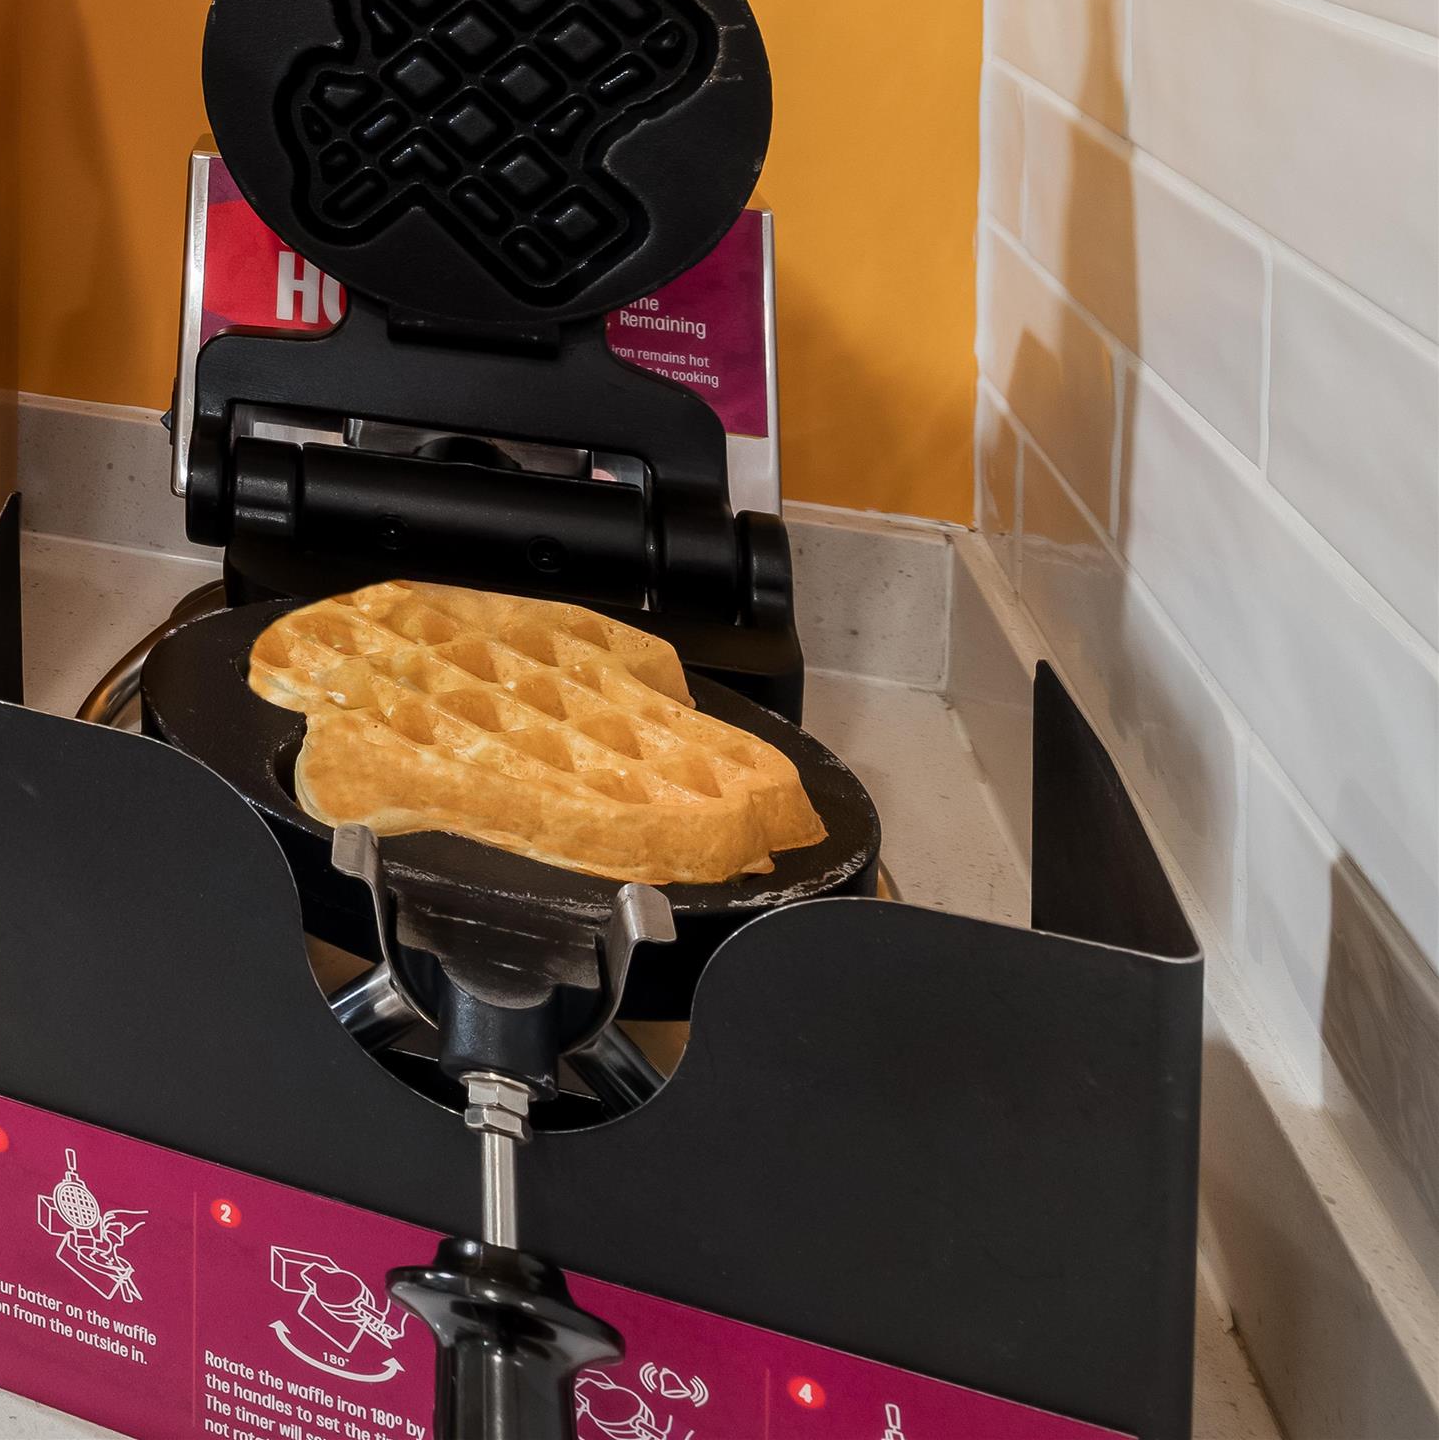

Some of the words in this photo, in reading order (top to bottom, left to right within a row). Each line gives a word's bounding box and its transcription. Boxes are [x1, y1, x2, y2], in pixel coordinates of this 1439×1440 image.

[619, 310, 706, 339] Remaining
[637, 350, 686, 365] remains
[689, 353, 710, 368] hot
[672, 369, 719, 388] cooking
[220, 1204, 234, 1224] 2
[18, 1284, 63, 1311] batter
[65, 1303, 83, 1320] on
[86, 1309, 110, 1329] the
[113, 1320, 157, 1346] waffle
[13, 1303, 46, 1328] from
[49, 1317, 73, 1338] the
[76, 1328, 129, 1357] outside
[131, 1345, 148, 1365] in.
[205, 1350, 255, 1381] Rotate
[258, 1368, 283, 1391] the
[287, 1380, 334, 1408] waffle
[337, 1395, 366, 1420] iron
[406, 1419, 426, 1440] by
[205, 1373, 230, 1394] the
[233, 1381, 293, 1417] handles
[296, 1405, 313, 1423] to
[316, 1413, 340, 1434] set
[344, 1421, 370, 1440] the
[800, 1383, 813, 1403] 4
[205, 1394, 232, 1415] The
[235, 1405, 276, 1432] timer
[279, 1419, 302, 1440] will
[205, 1418, 229, 1438] not
